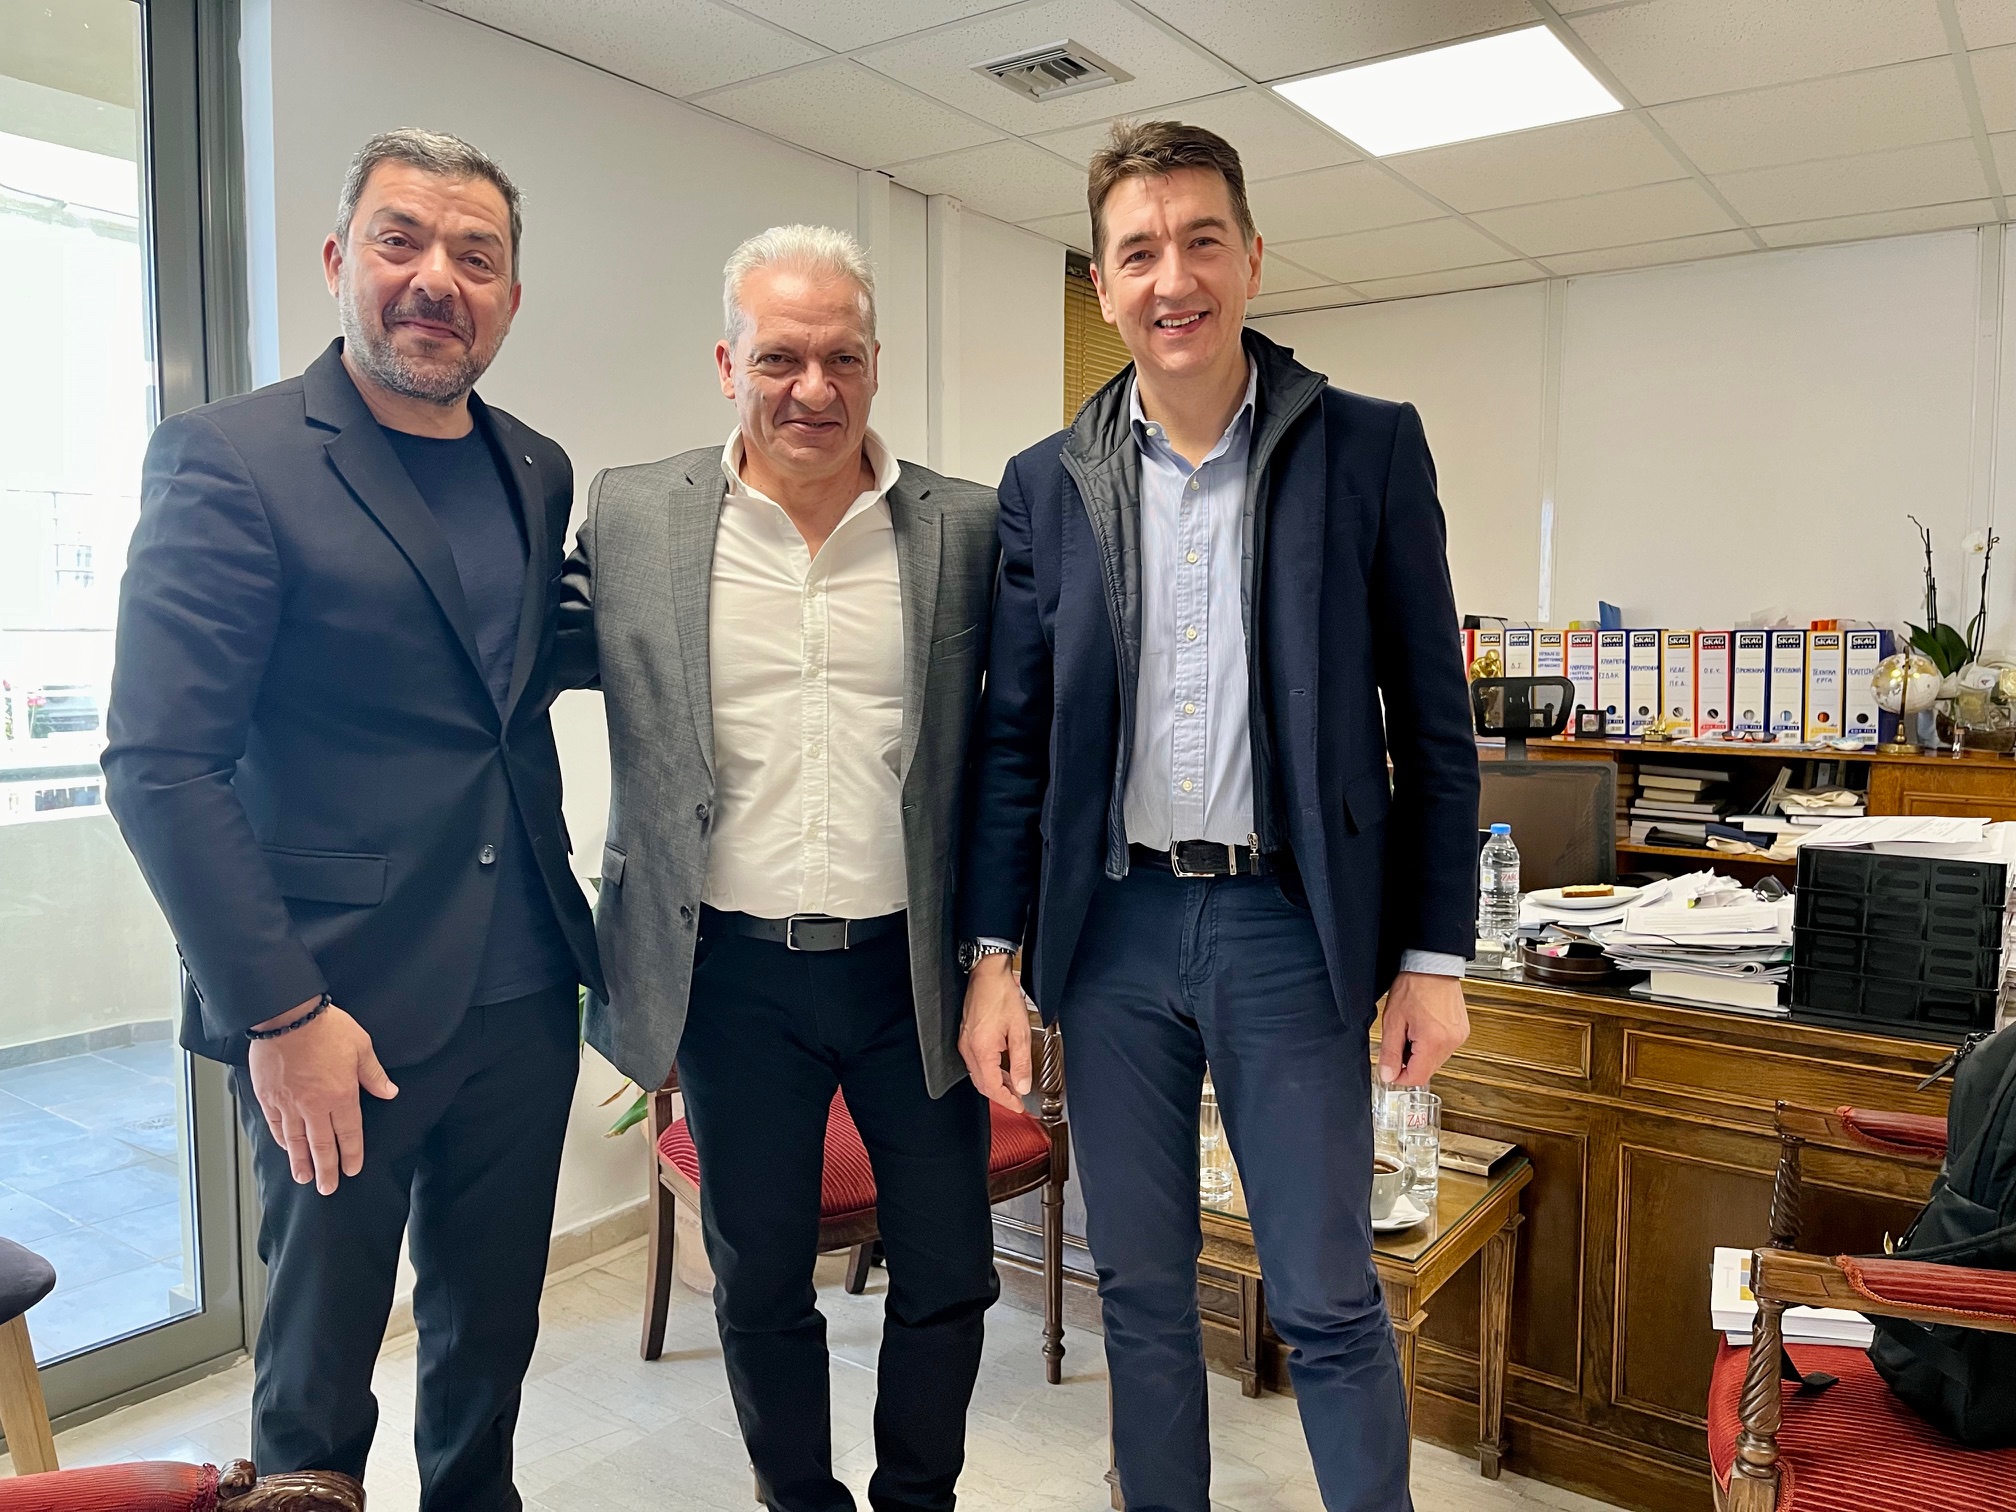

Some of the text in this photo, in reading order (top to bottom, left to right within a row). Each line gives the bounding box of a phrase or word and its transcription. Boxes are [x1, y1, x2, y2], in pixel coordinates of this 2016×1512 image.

[1572, 635, 1592, 644] SKAG
[1602, 635, 1622, 644] SKAG
[1634, 635, 1654, 644] SKAG
[1668, 636, 1689, 645] SKAG
[1703, 637, 1724, 646] SKAG
[1740, 636, 1762, 645] SKAG
[1777, 635, 1800, 645] SKAG
[1815, 637, 1838, 646] SKAG
[1852, 636, 1876, 646] SKAG
